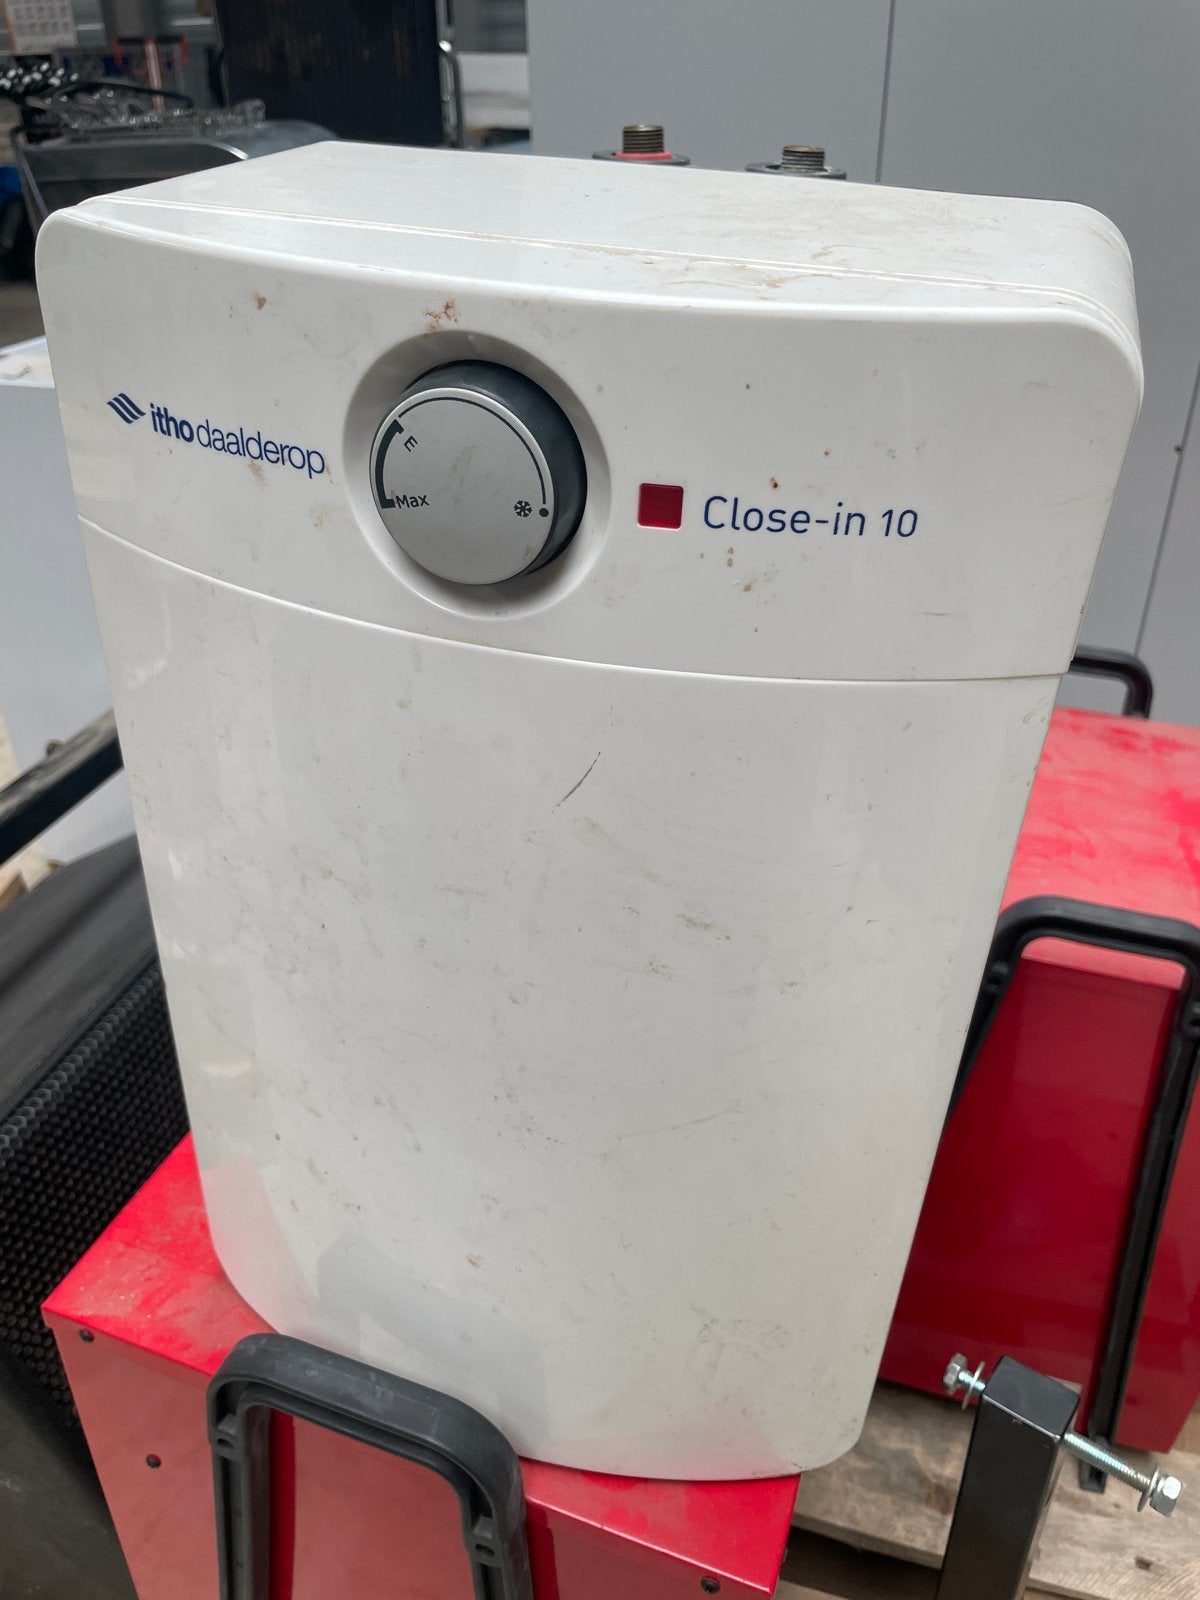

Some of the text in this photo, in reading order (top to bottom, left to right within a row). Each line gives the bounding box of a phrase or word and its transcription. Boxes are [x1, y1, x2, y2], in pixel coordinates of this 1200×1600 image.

[403, 435, 418, 452] E
[395, 494, 430, 509] Max
[703, 495, 918, 538] Close-in 10
